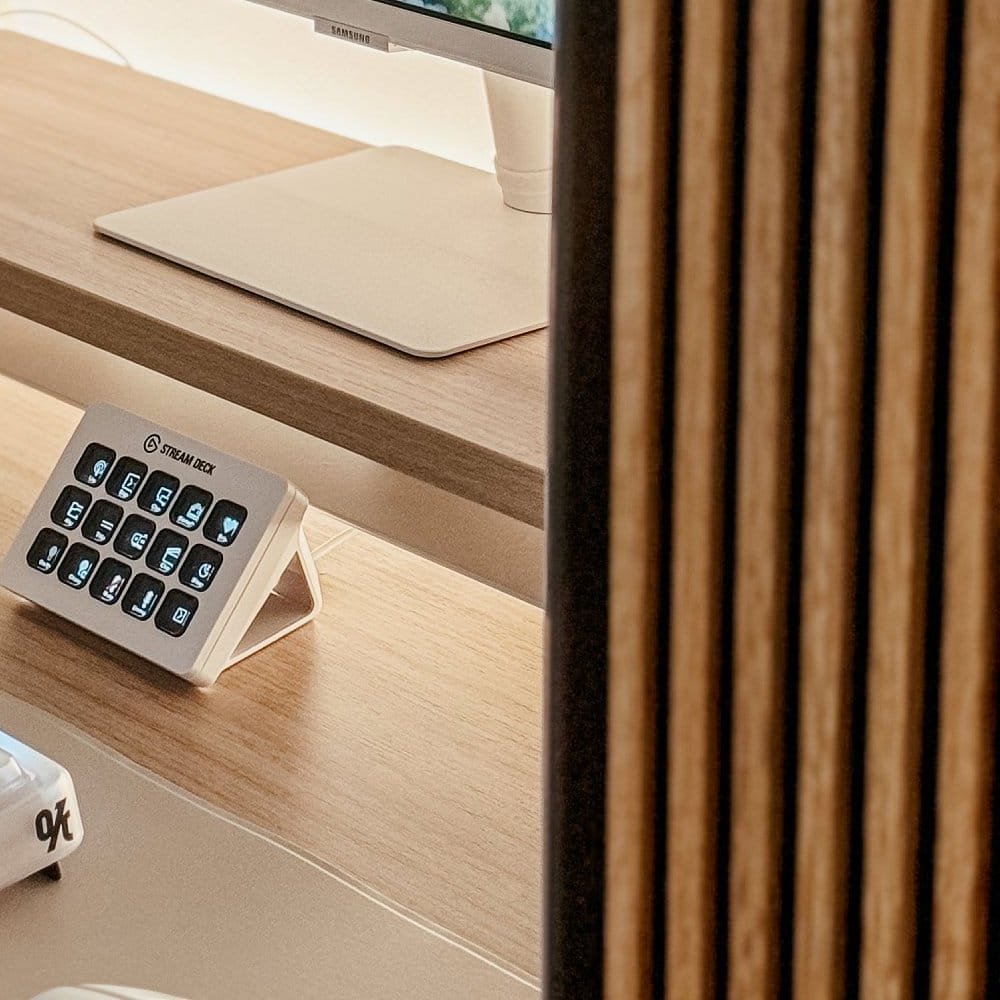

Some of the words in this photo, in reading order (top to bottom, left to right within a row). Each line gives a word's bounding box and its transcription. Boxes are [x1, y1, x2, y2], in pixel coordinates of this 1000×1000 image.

[331, 25, 370, 44] SAMSUNG
[160, 444, 195, 466] STREAM
[192, 458, 216, 476] DECK
